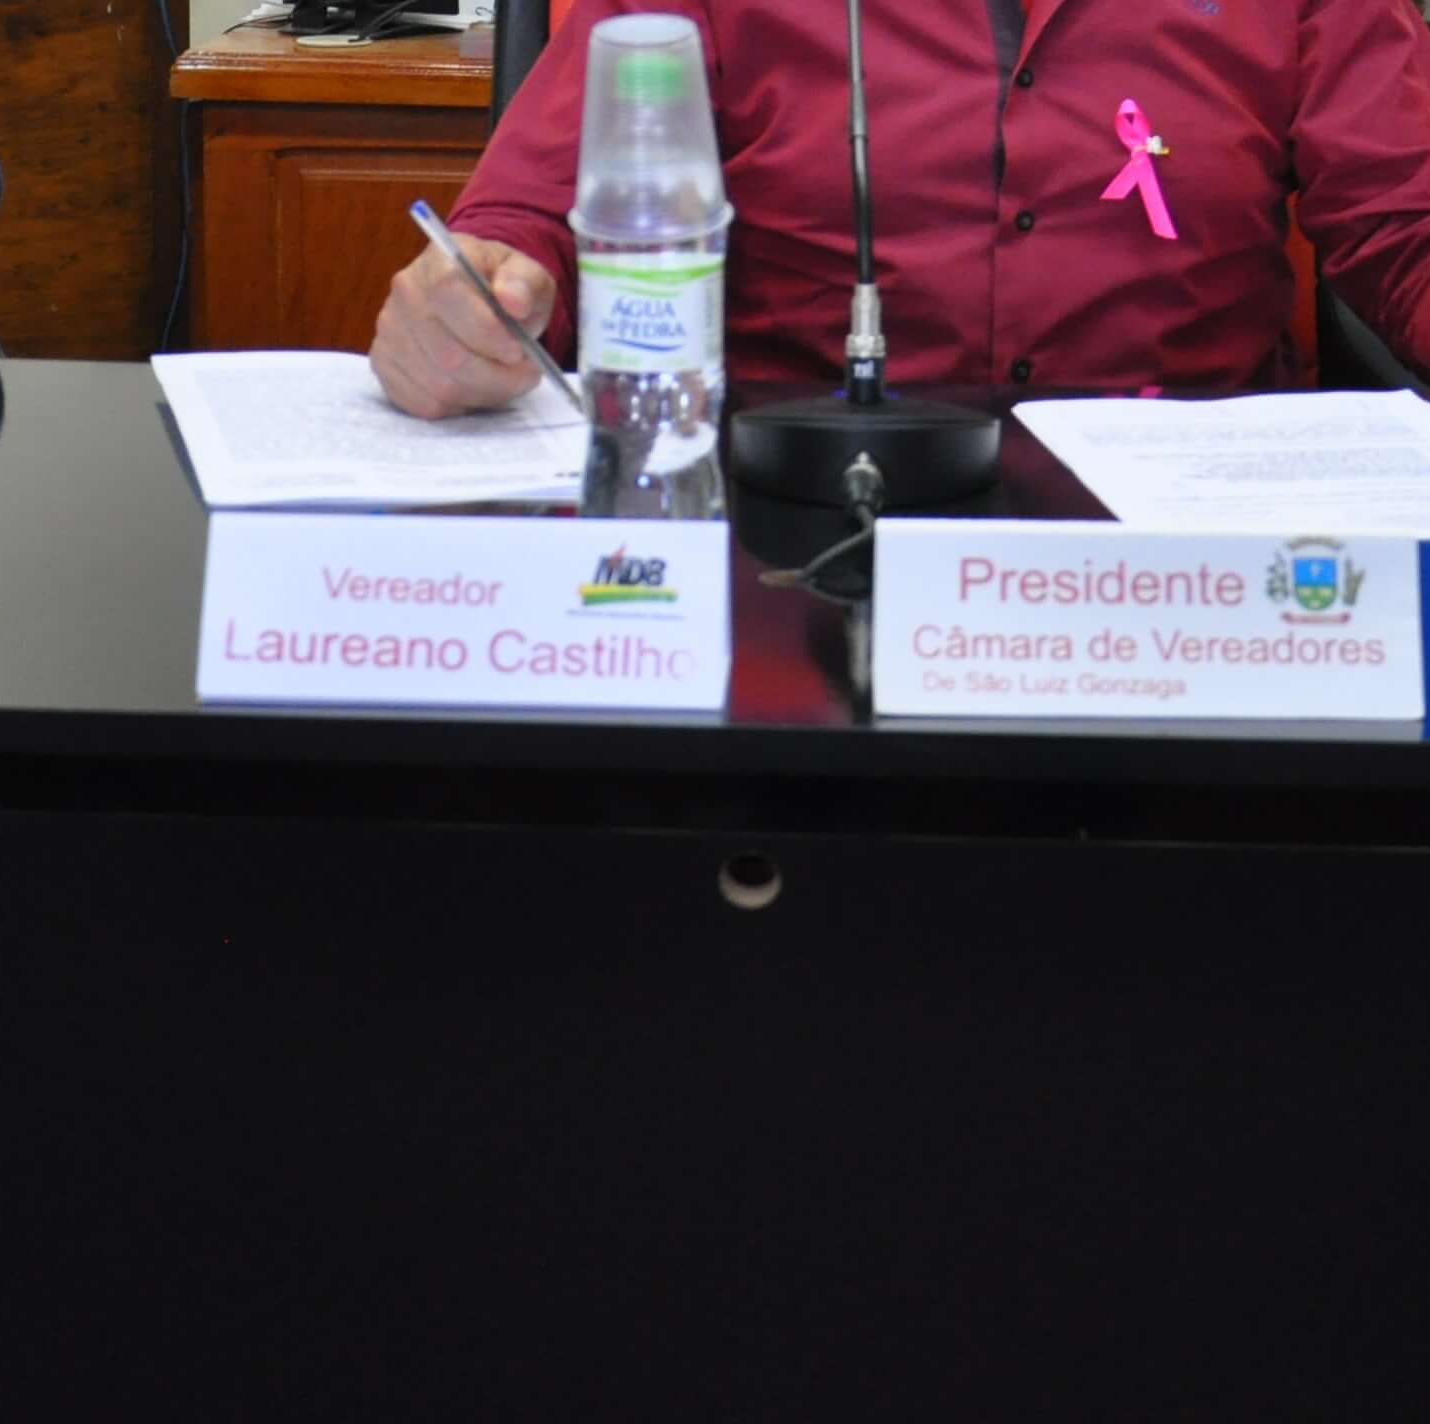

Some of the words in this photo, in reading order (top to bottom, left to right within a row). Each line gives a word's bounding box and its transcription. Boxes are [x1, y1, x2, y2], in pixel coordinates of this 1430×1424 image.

[322, 567, 504, 607] Vereador
[959, 557, 1246, 607] Presidente
[224, 619, 469, 671] Laureano
[488, 628, 695, 681] Castilho
[913, 624, 1073, 661] Câmara
[1087, 631, 1139, 664] de
[1151, 630, 1386, 665] Vereadores
[923, 672, 956, 692] De
[963, 671, 1011, 693] São
[1019, 672, 1069, 694] Luiz
[1076, 673, 1187, 700] Gonzaga
